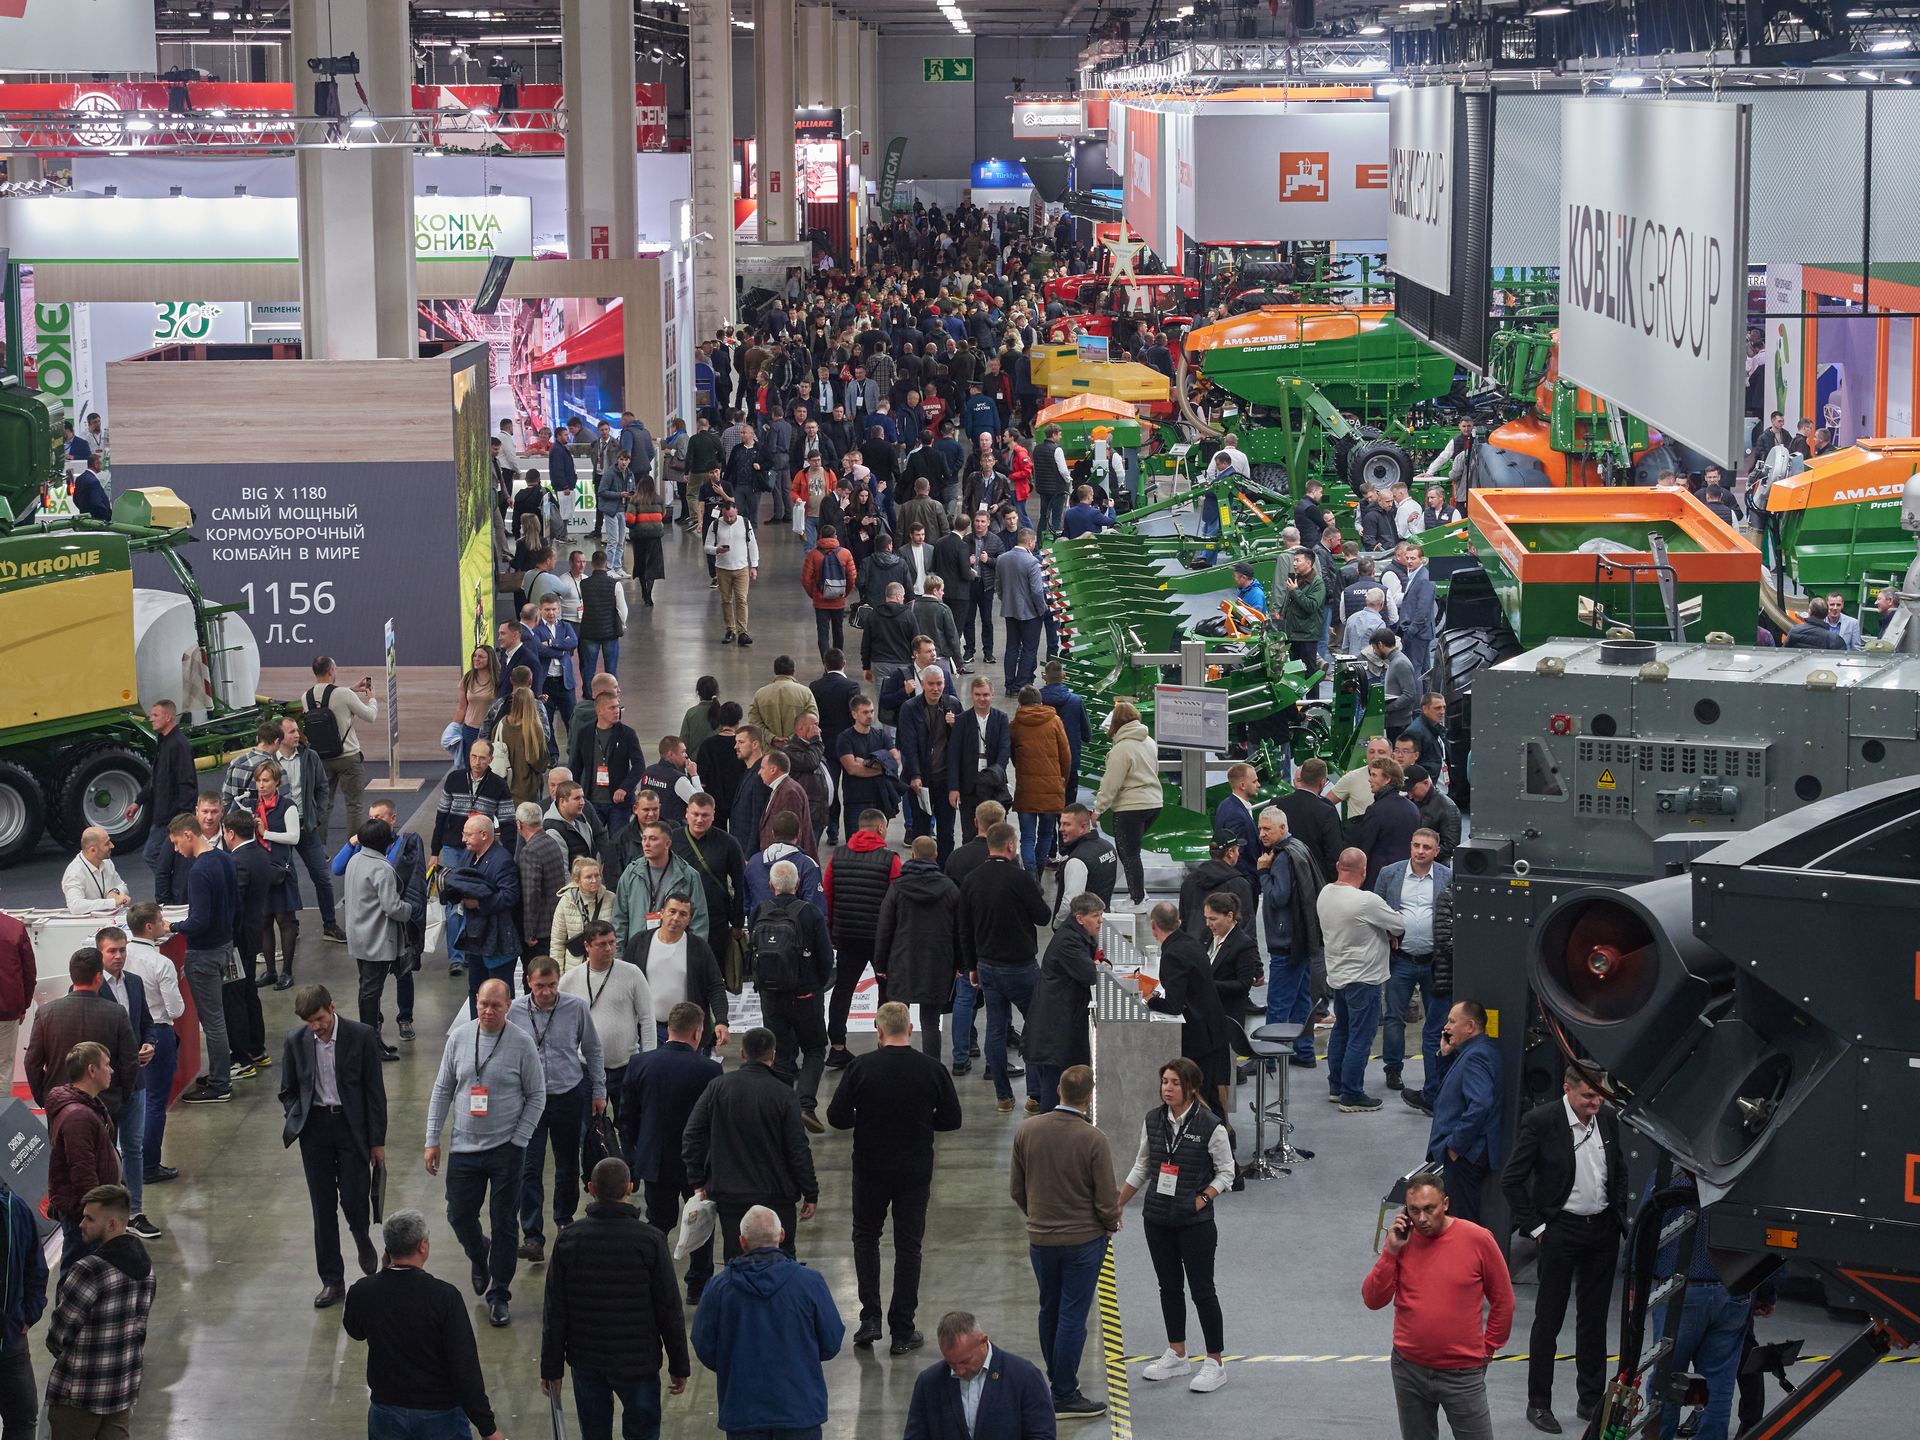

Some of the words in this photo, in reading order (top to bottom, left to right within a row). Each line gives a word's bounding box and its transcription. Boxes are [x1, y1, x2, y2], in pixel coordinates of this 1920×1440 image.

[795, 120, 833, 130] ALLIANCE
[1415, 149, 1444, 226] GROUP
[1640, 219, 1721, 360] GROUP
[154, 301, 211, 339] 30
[1223, 334, 1288, 347] AMAZONE
[1242, 343, 1266, 352] Cirrus
[242, 487, 268, 500] BIG
[292, 486, 327, 500] 1180
[211, 504, 272, 521] САМЫЙ
[279, 504, 358, 522] МОЩНЫЙ
[206, 523, 365, 541] КОРМОУБОРОЧНЫЙ
[212, 545, 291, 561] КОМБАЙН
[300, 547, 309, 560] В
[316, 547, 360, 560] МИРЕ
[21, 549, 100, 578] KRONE
[240, 581, 336, 615] 1156
[265, 623, 314, 644] Л.С.
